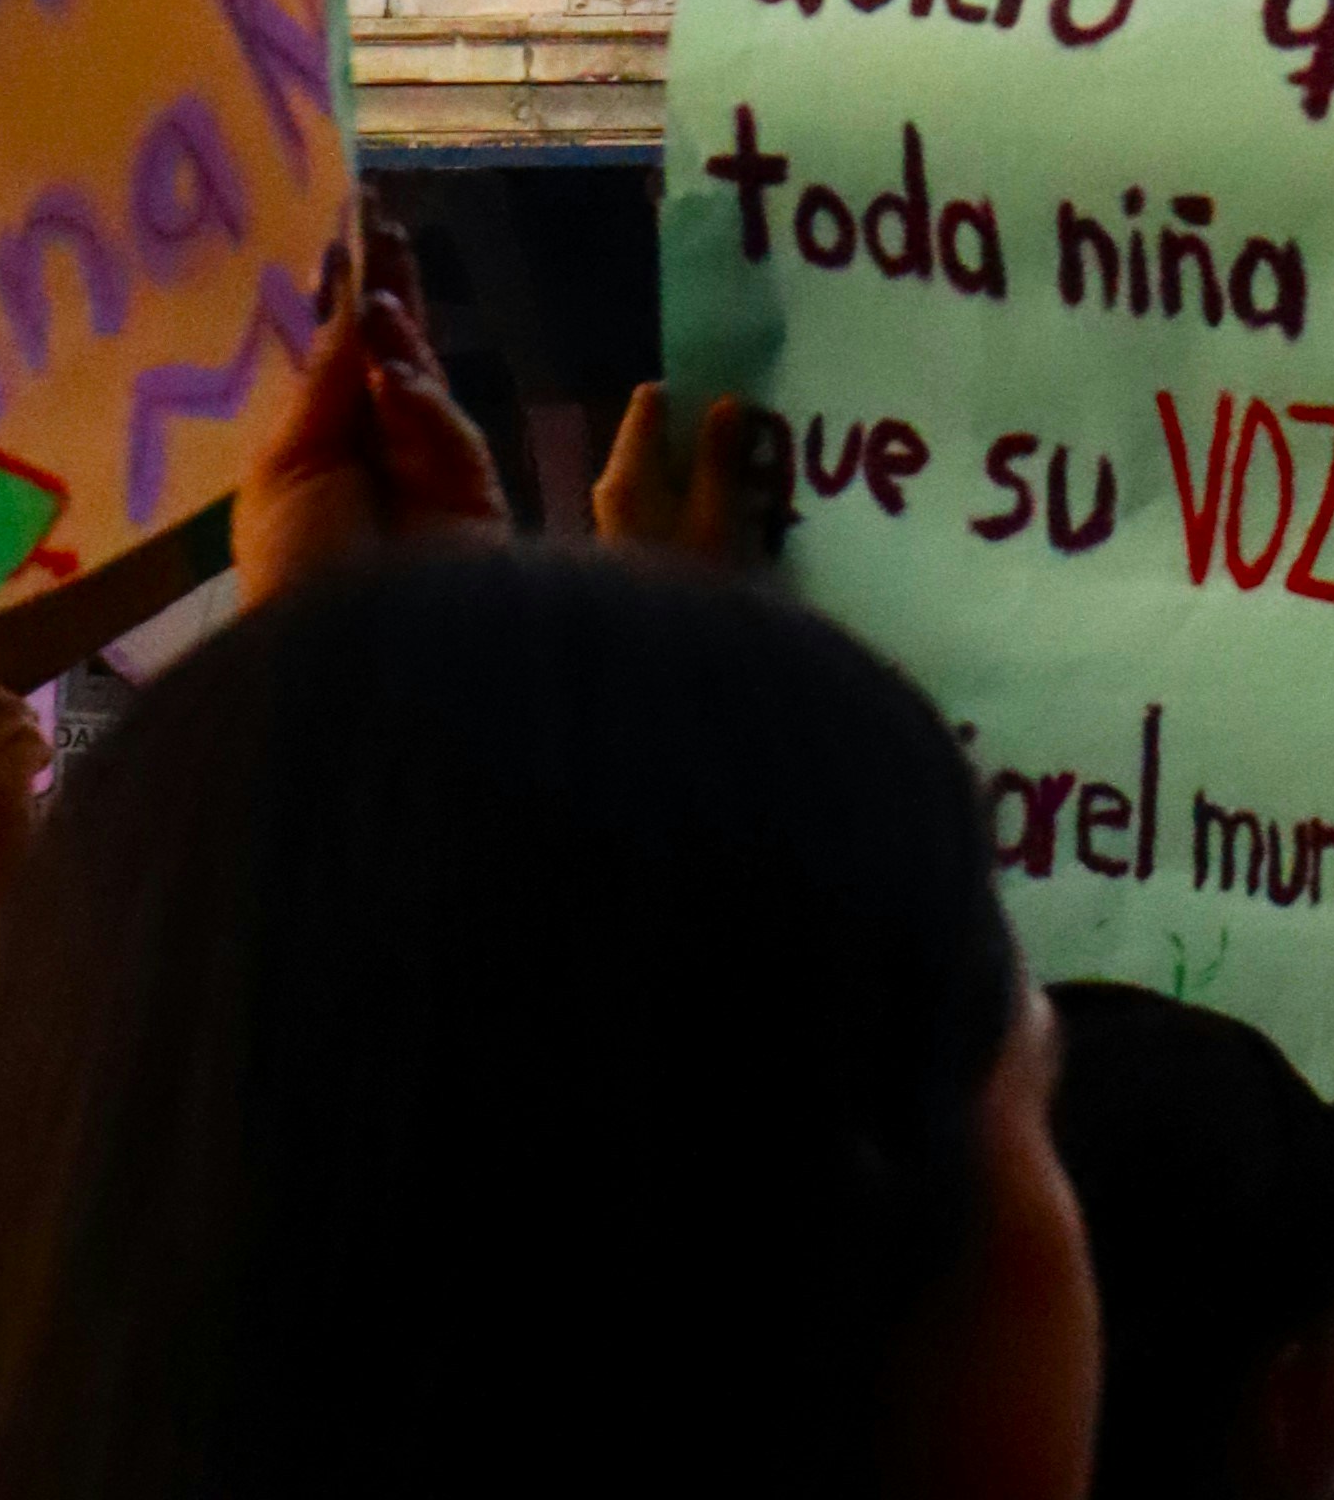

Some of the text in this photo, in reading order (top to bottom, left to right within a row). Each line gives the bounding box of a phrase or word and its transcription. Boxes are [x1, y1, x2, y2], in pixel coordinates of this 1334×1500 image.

[705, 102, 1008, 301] toda
[1057, 185, 1310, 343] niña
[967, 430, 1119, 556] su
